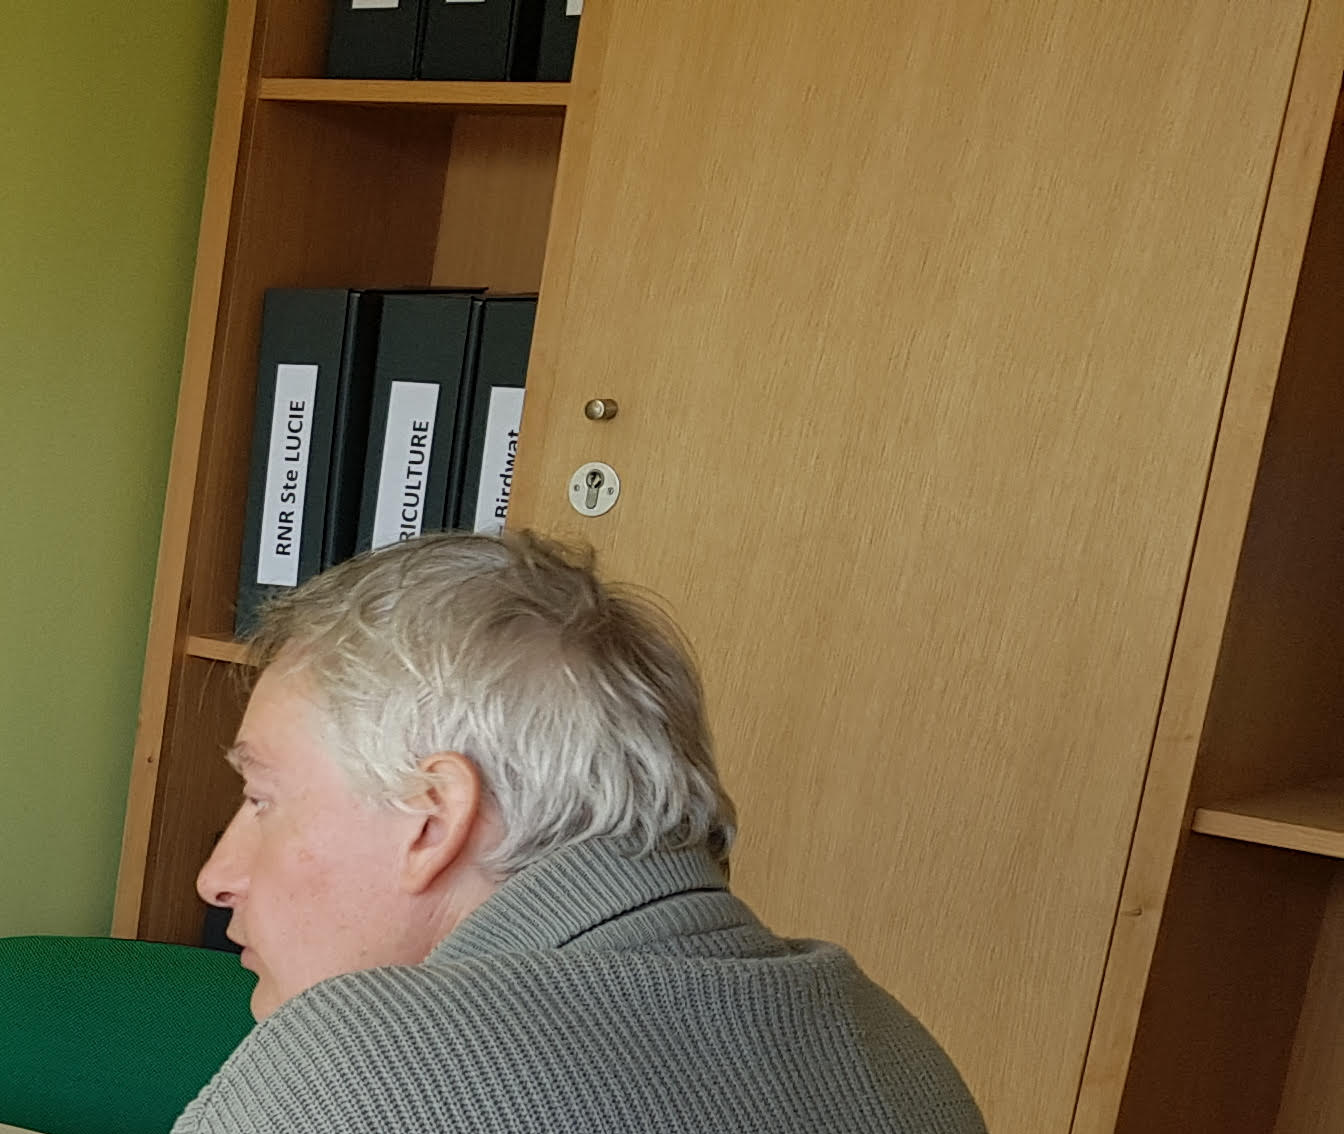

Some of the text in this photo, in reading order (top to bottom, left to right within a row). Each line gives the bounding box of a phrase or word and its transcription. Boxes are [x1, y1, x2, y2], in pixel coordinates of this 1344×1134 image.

[276, 400, 306, 556] RNR Ste LUCIE
